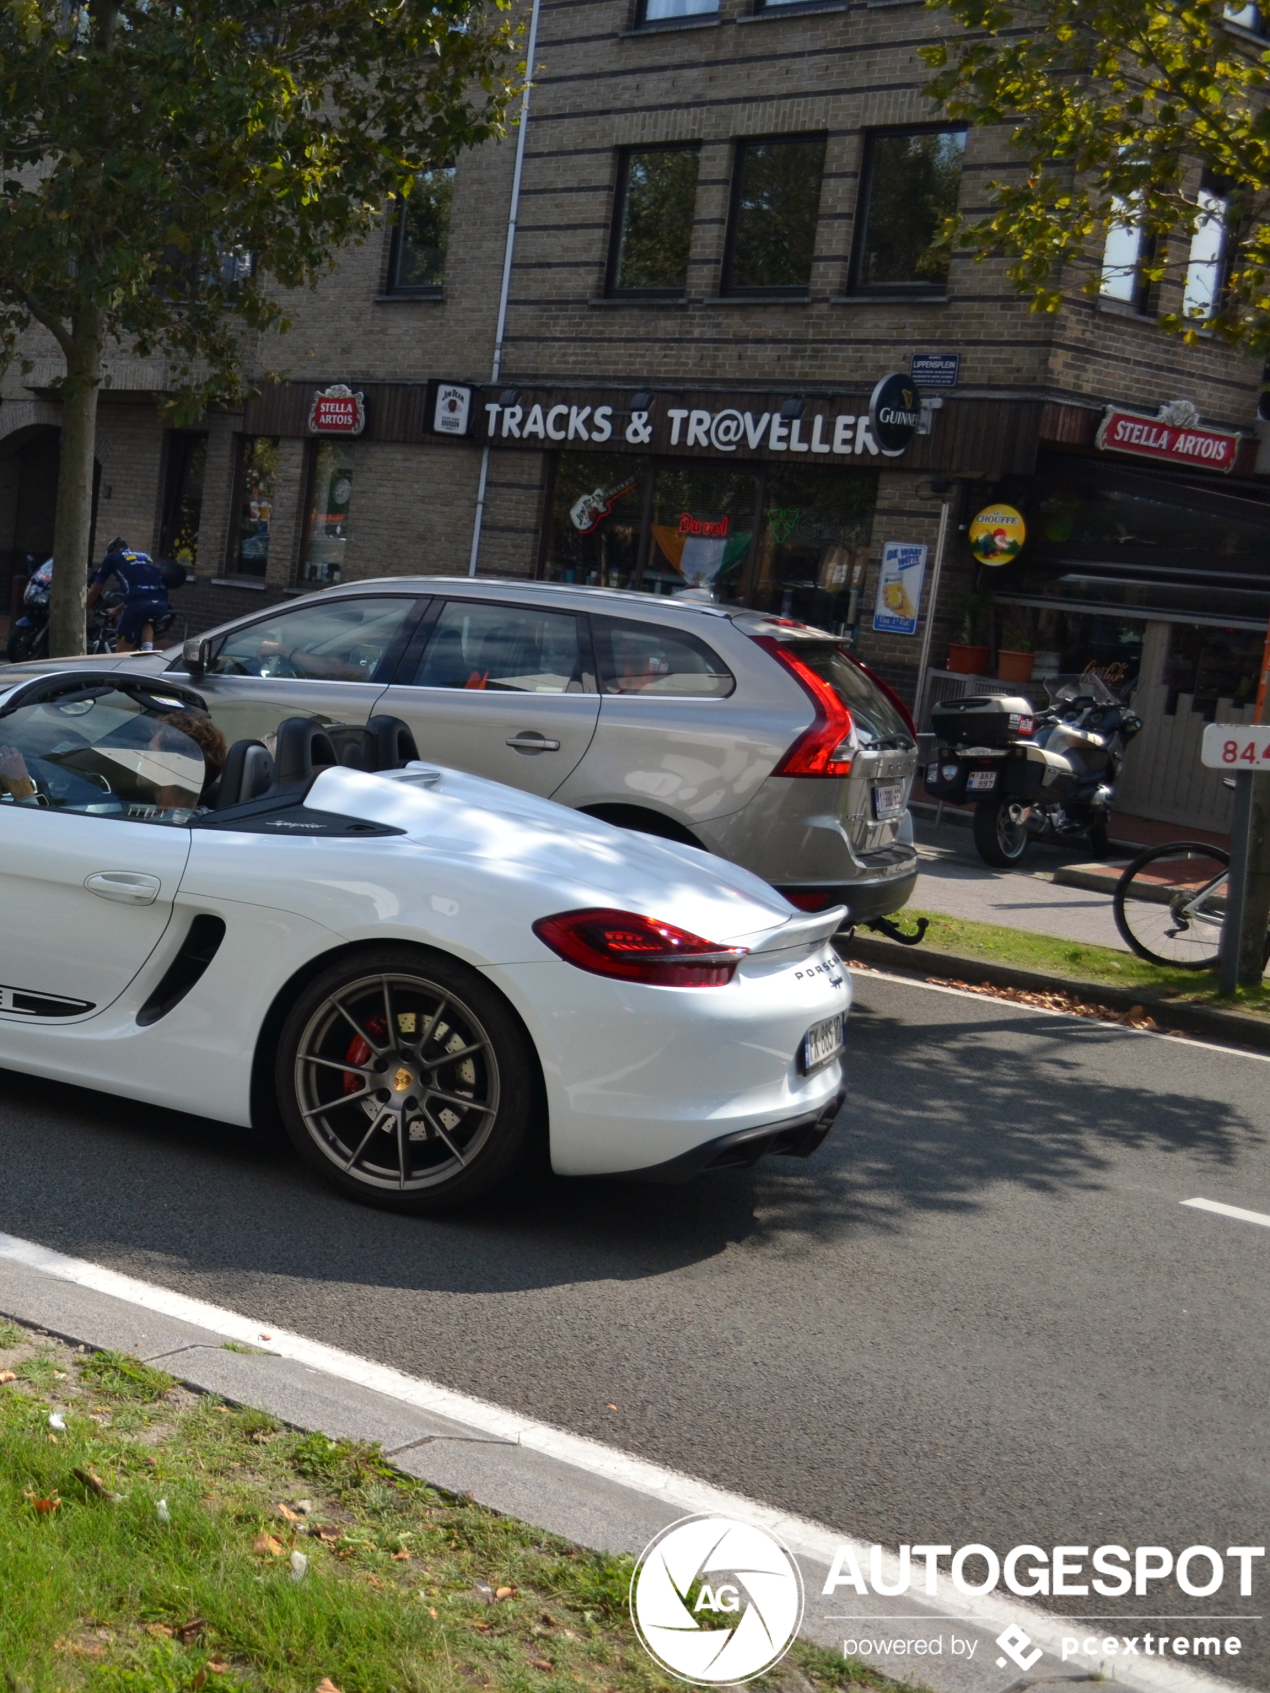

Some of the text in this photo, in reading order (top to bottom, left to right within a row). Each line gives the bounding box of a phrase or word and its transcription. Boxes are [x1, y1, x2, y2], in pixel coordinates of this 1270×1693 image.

[912, 360, 956, 369] LIPPENSPLEIN
[320, 403, 353, 414] STELLA
[319, 414, 353, 425] ARTOIS
[485, 403, 904, 457] TRACKS & TR@VELLER
[1114, 420, 1227, 461] STELLA ARTOIS
[679, 512, 729, 537] Duvel
[976, 515, 1018, 525] CHOUFFE
